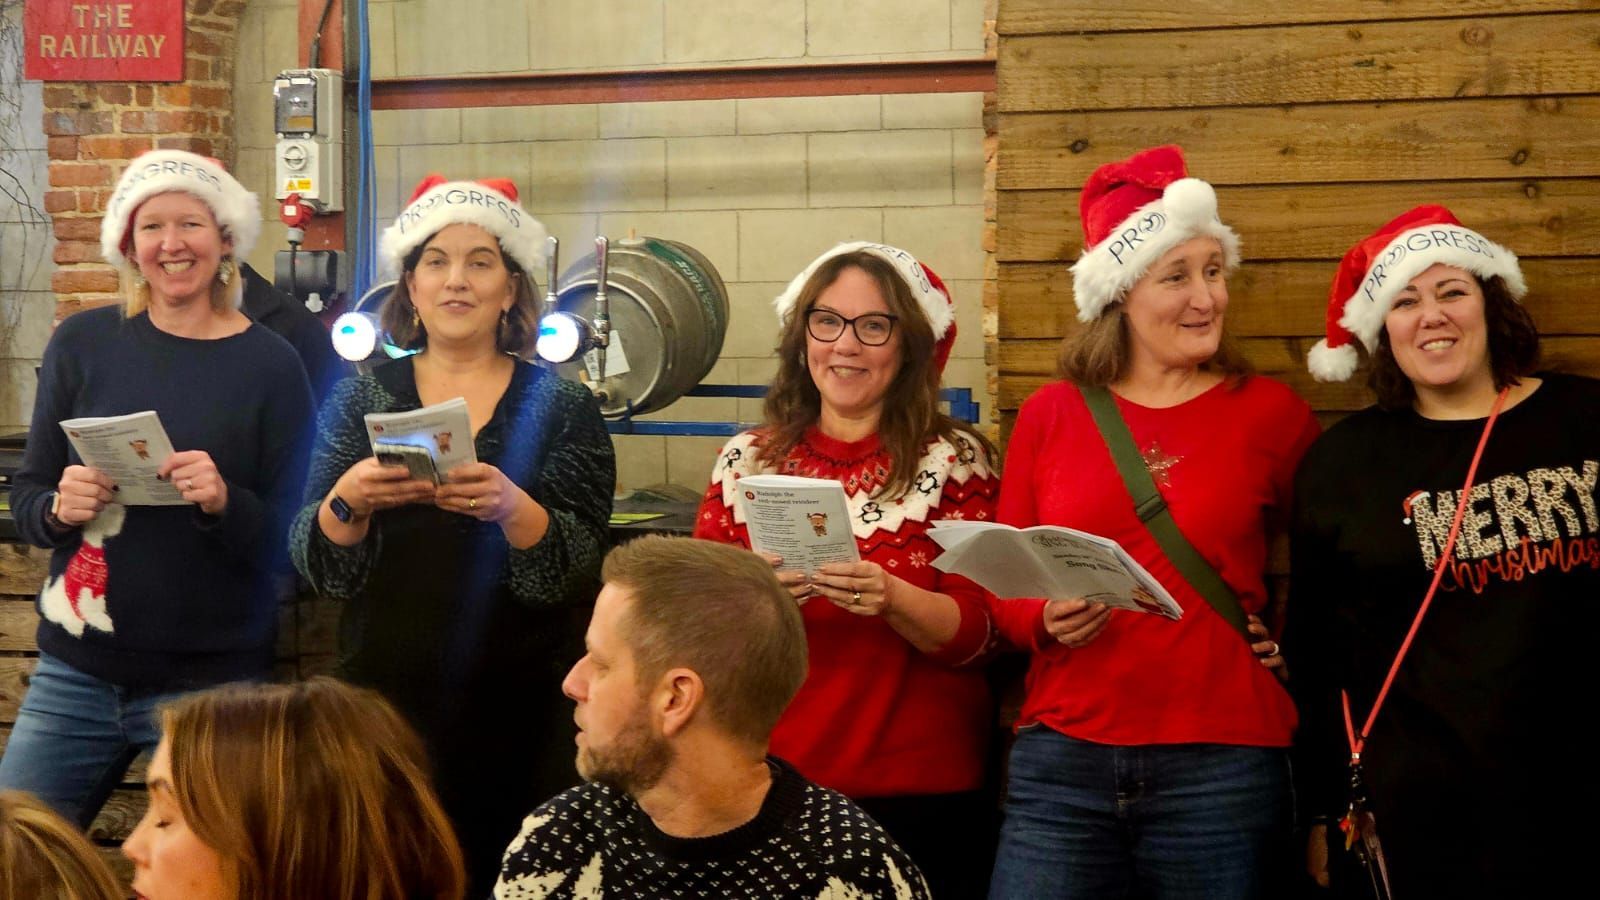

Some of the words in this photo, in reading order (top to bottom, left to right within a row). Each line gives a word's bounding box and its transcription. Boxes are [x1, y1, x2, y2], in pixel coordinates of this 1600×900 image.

[73, 4, 133, 28] THE
[40, 34, 166, 58] RAILWAY
[1363, 229, 1495, 302] PROGRESS
[1413, 460, 1600, 571] MERRY
[1065, 560, 1097, 570] Song
